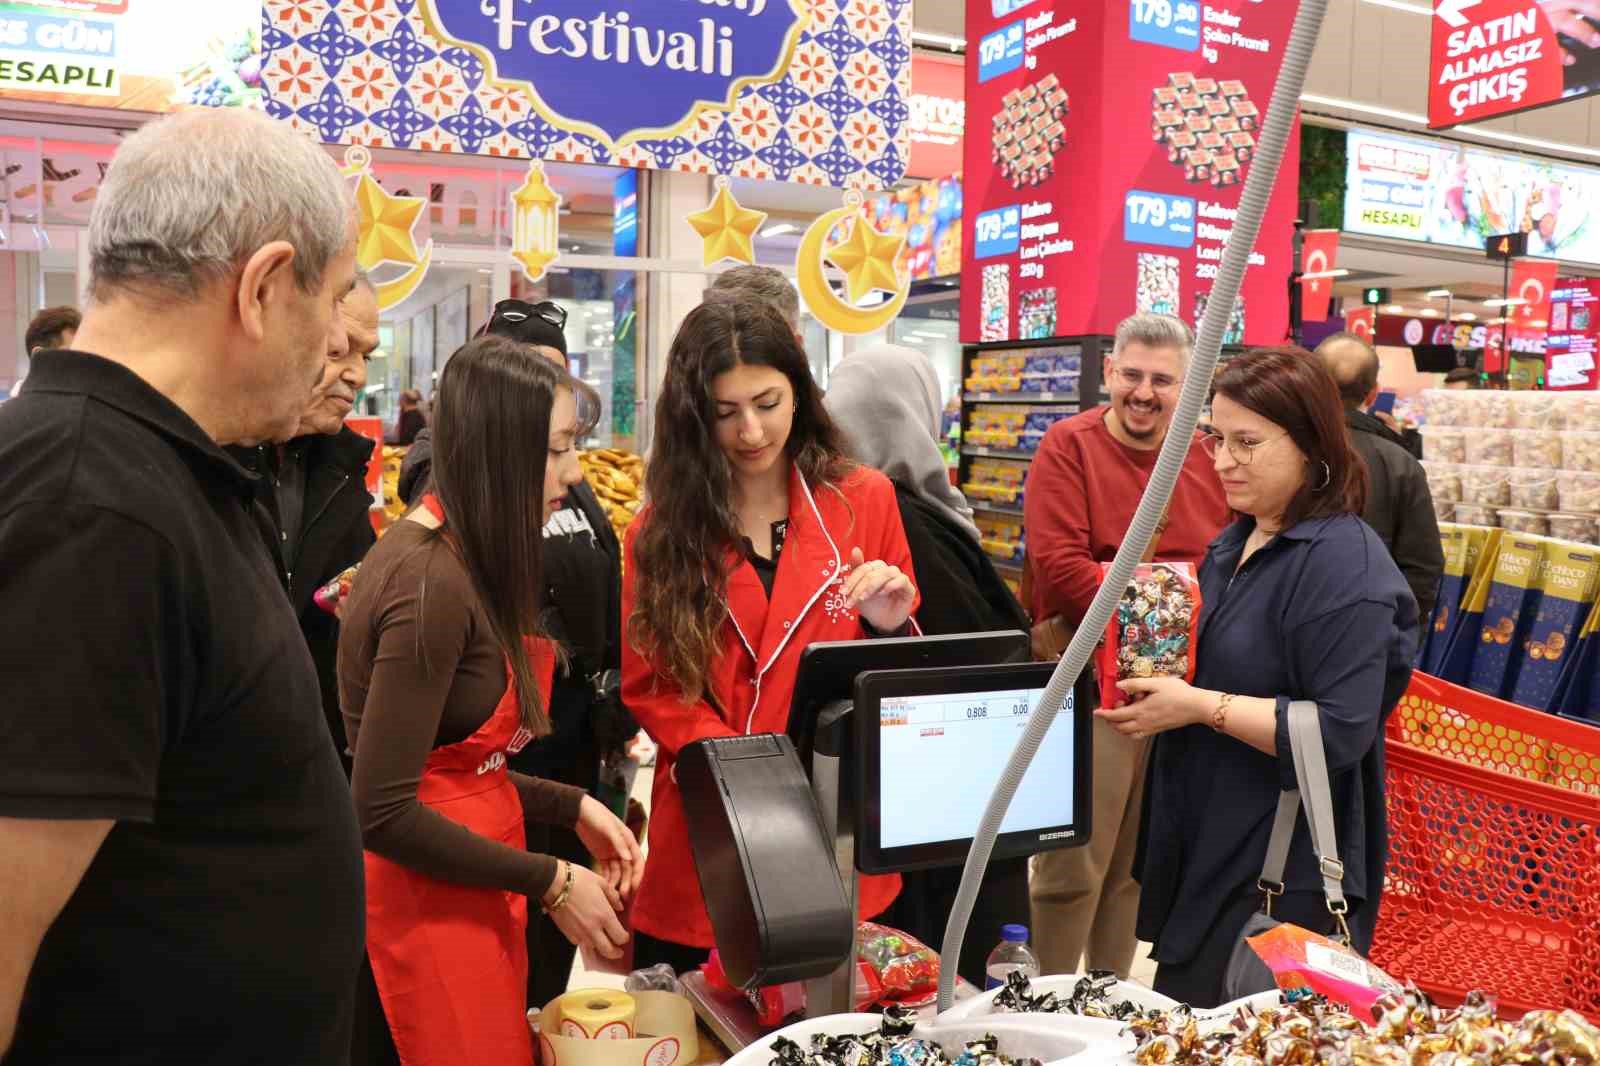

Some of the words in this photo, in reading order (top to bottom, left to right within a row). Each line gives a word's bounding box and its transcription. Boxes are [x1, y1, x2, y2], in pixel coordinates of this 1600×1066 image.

[480, 0, 734, 77] Festivali
[1446, 8, 1537, 58] SATIN
[1202, 44, 1218, 63] kg
[1438, 37, 1543, 85] ALMASIZ
[0, 59, 115, 88] ESAPLI
[1448, 67, 1528, 116] ÇIKIŞ
[1362, 208, 1421, 228] HESAPLI
[1498, 236, 1510, 254] 4
